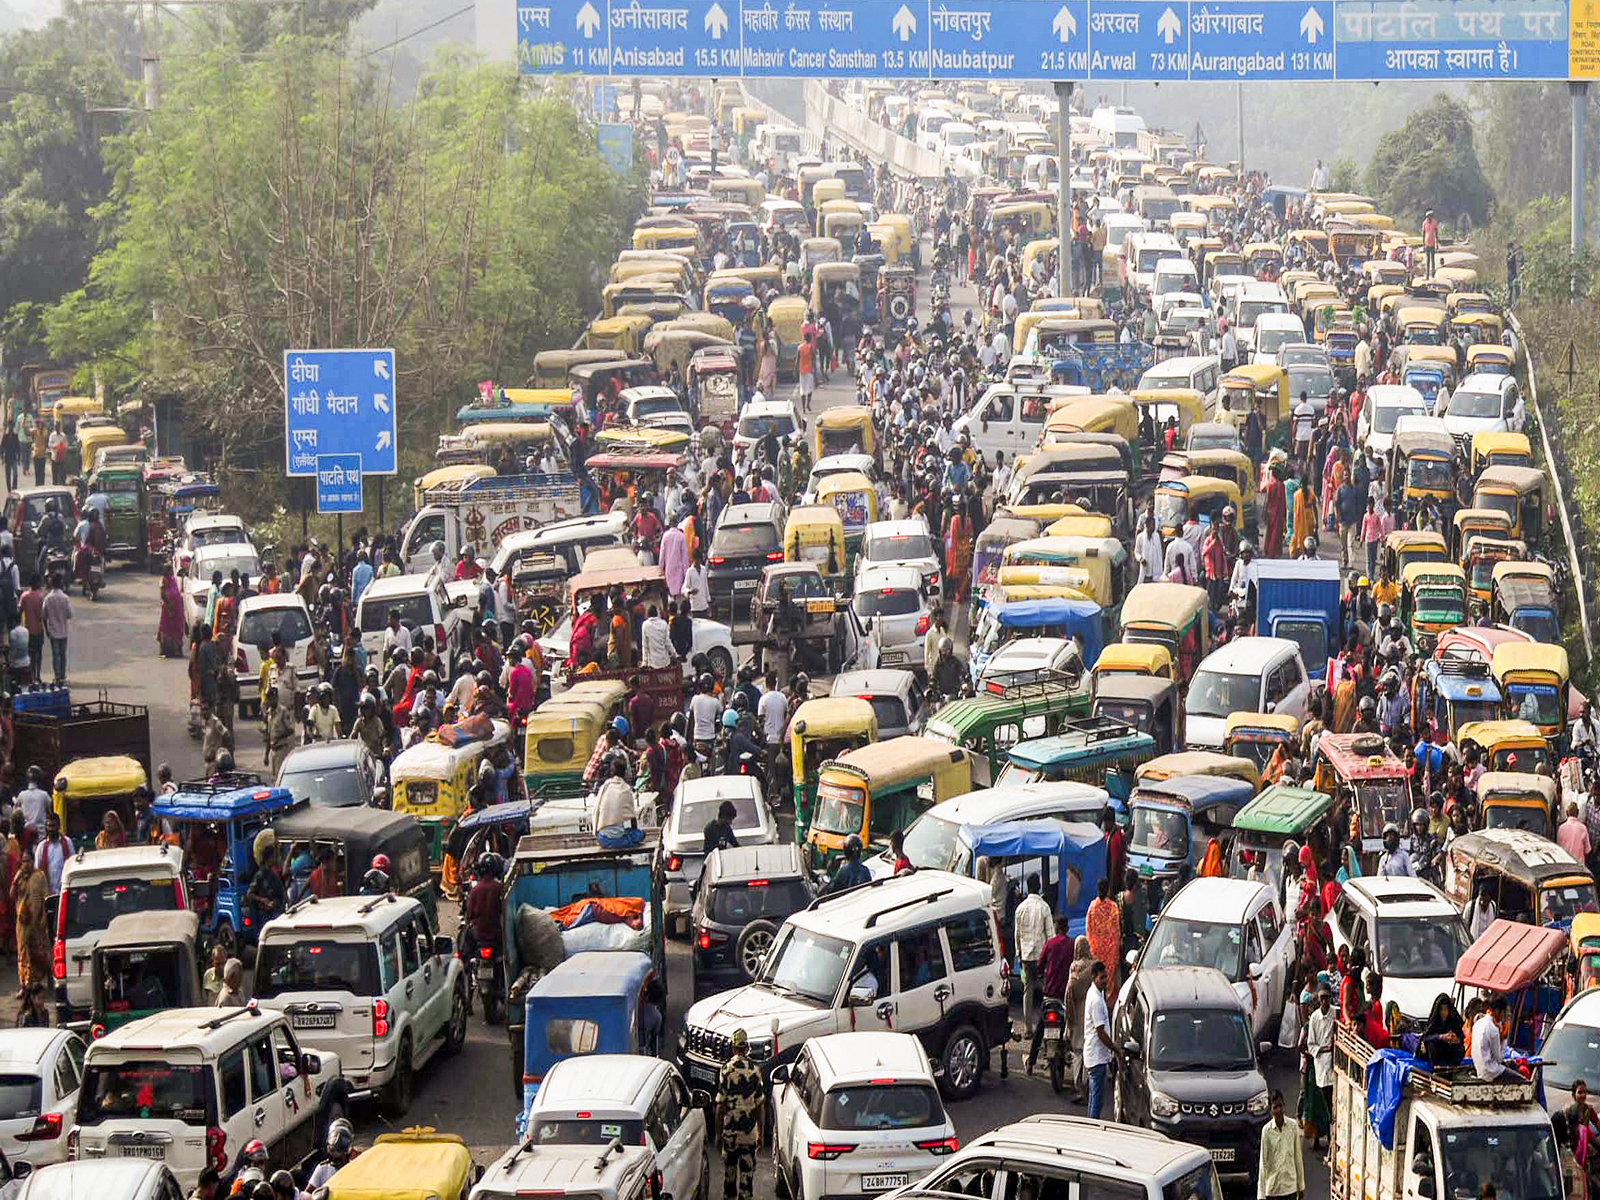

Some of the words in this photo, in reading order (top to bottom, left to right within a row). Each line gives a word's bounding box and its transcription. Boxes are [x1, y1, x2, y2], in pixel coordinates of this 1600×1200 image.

[518, 7, 551, 32] एम्स
[611, 0, 688, 30] अनीसाबाद
[743, 2, 779, 32] महावीर
[818, 3, 854, 32] संस्थान
[932, 4, 992, 41] नौबतपुर
[1091, 12, 1140, 34] अरवल
[1191, 5, 1265, 35] औरंगाबाद
[1341, 3, 1439, 39] पाटलि
[1454, 11, 1505, 36] पथ
[572, 48, 584, 66] 11
[588, 48, 609, 66] KM
[612, 47, 684, 67] Anisabad
[694, 48, 718, 67] 15.5
[721, 49, 740, 67] KM
[743, 48, 784, 68] Mahavir
[789, 48, 826, 68] Cancer
[829, 48, 877, 69] Sansthan
[882, 51, 904, 69] 13.5
[909, 51, 928, 69] KM
[932, 48, 1015, 73] Naubatpur
[1041, 52, 1065, 70] 21.5
[1068, 52, 1088, 70] KM
[1091, 49, 1136, 71] Arwal
[1150, 52, 1165, 72] 73
[1168, 52, 1187, 72] KM
[1192, 51, 1285, 76] Aurangabad
[1291, 52, 1310, 71] 131
[1313, 52, 1333, 71] KM
[1385, 48, 1440, 71] आपका
[1444, 49, 1494, 71] स्वागत
[291, 357, 319, 383] दीघा
[326, 389, 359, 415] मैदान
[292, 429, 318, 451] एम्स
